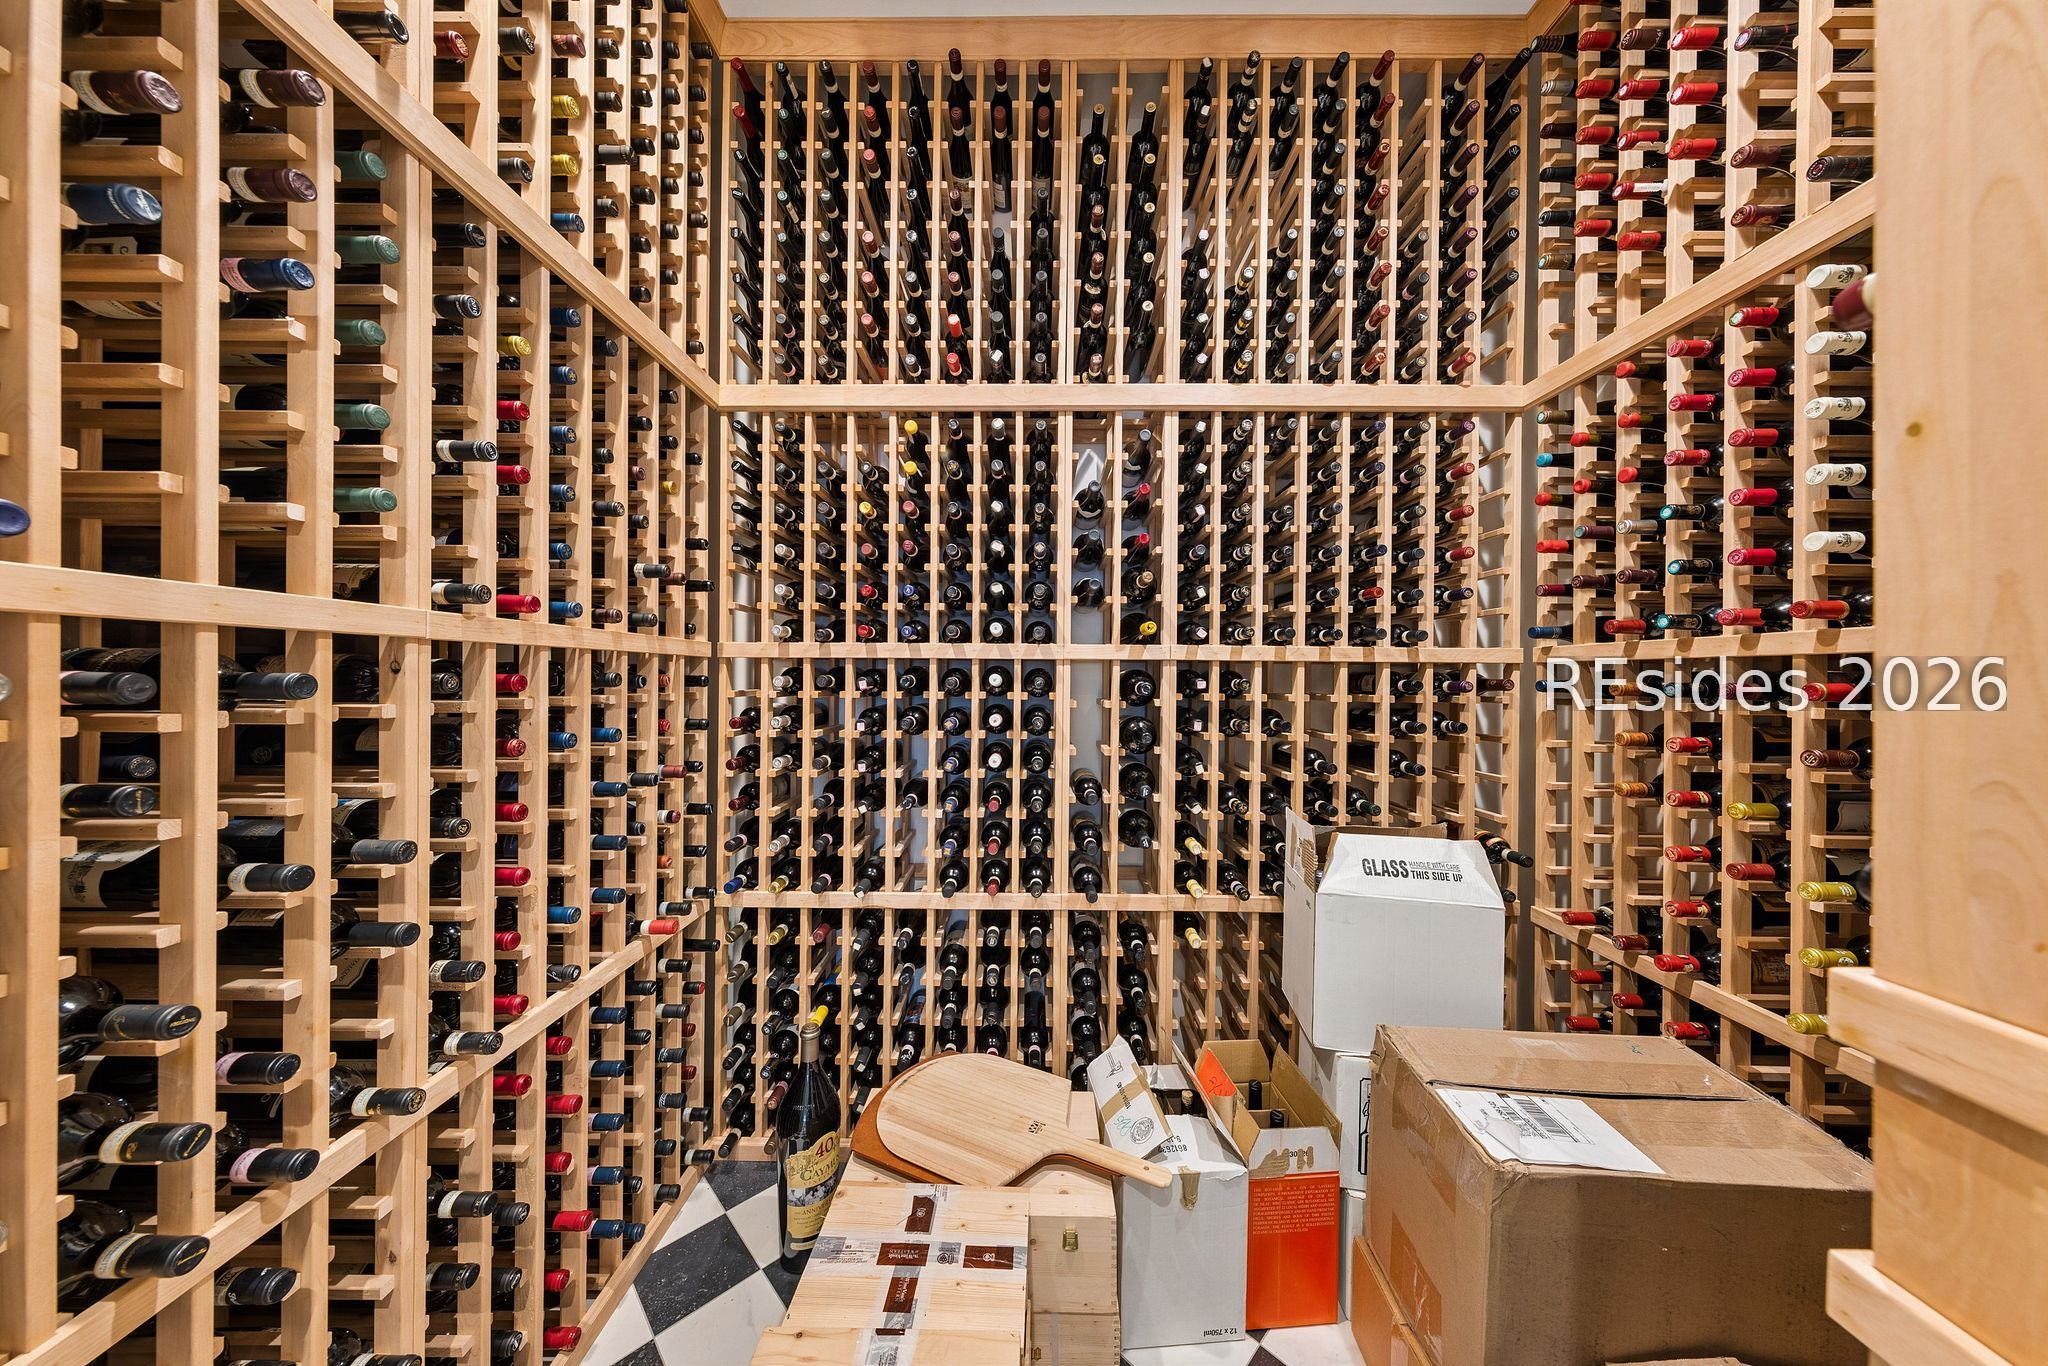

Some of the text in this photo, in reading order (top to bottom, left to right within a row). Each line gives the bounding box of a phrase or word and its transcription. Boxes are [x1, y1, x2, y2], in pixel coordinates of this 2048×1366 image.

[1361, 858, 1409, 879] GLASS
[1446, 863, 1460, 871] CARE
[1411, 870, 1463, 883] THIS SIDE UP
[815, 1136, 834, 1158] 40
[1203, 1329, 1223, 1337] 750ml
